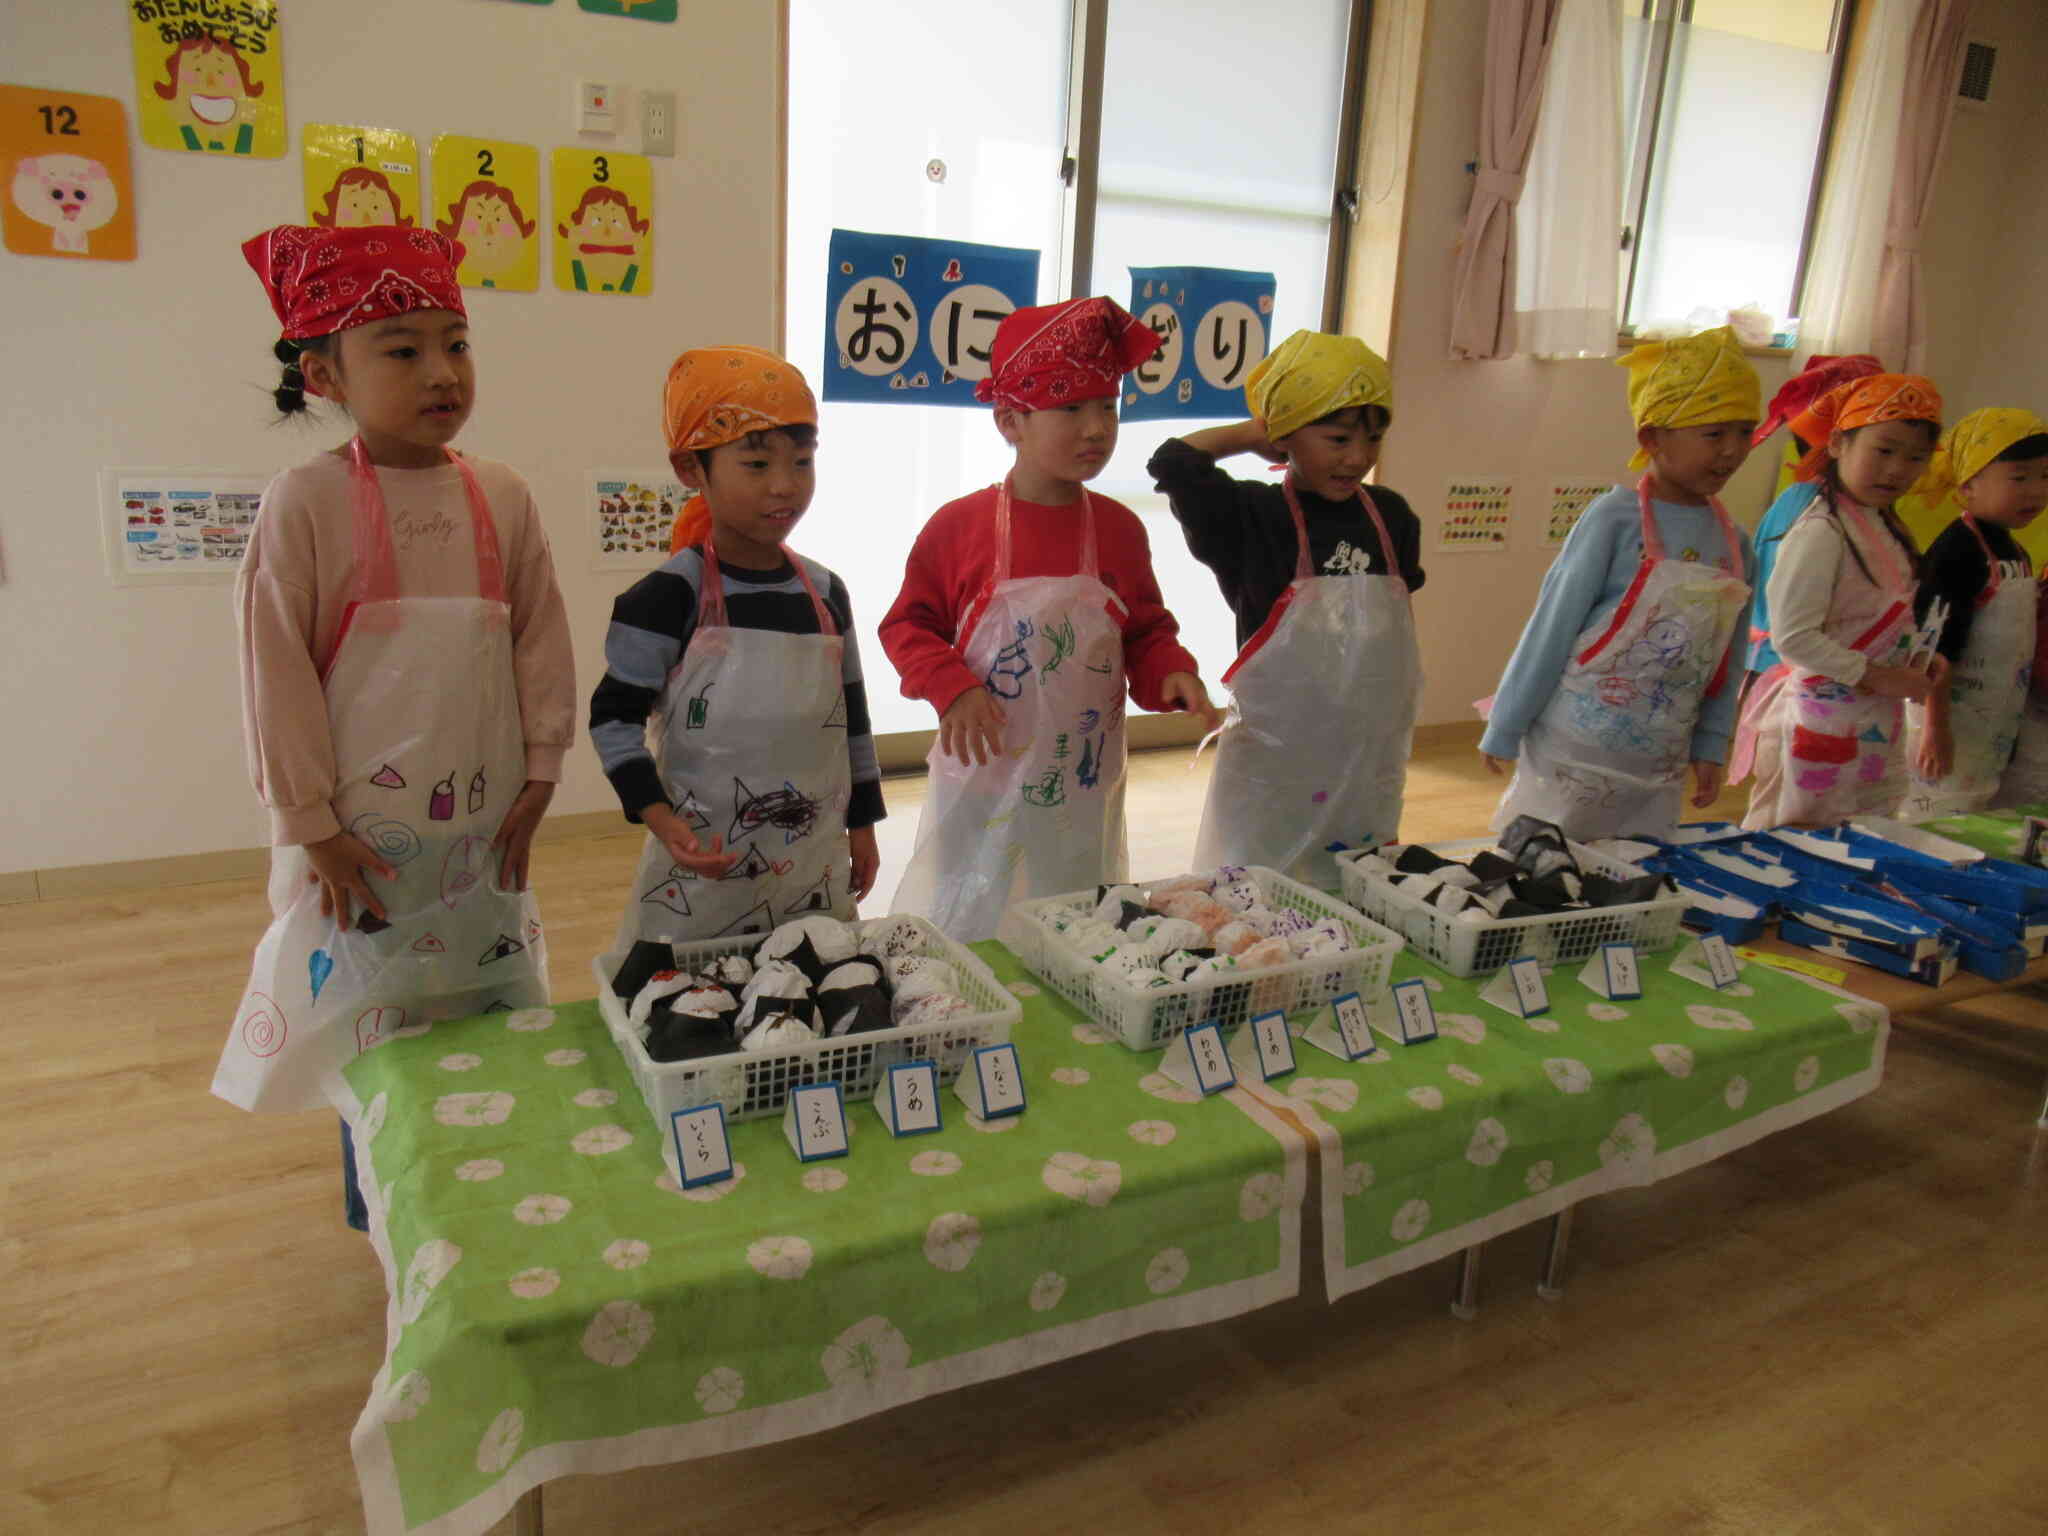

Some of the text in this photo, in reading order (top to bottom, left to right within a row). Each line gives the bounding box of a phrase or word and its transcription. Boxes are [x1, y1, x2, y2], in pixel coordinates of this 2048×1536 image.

[134, 0, 278, 31] おたんじょうび
[158, 19, 267, 54] おめでとう
[38, 105, 80, 135] 12
[352, 136, 364, 163] 1
[477, 150, 495, 176] 2
[592, 156, 609, 183] 3
[906, 1077, 924, 1112] うめ
[812, 1101, 831, 1139] こんぶ
[690, 1118, 711, 1162] いくら
